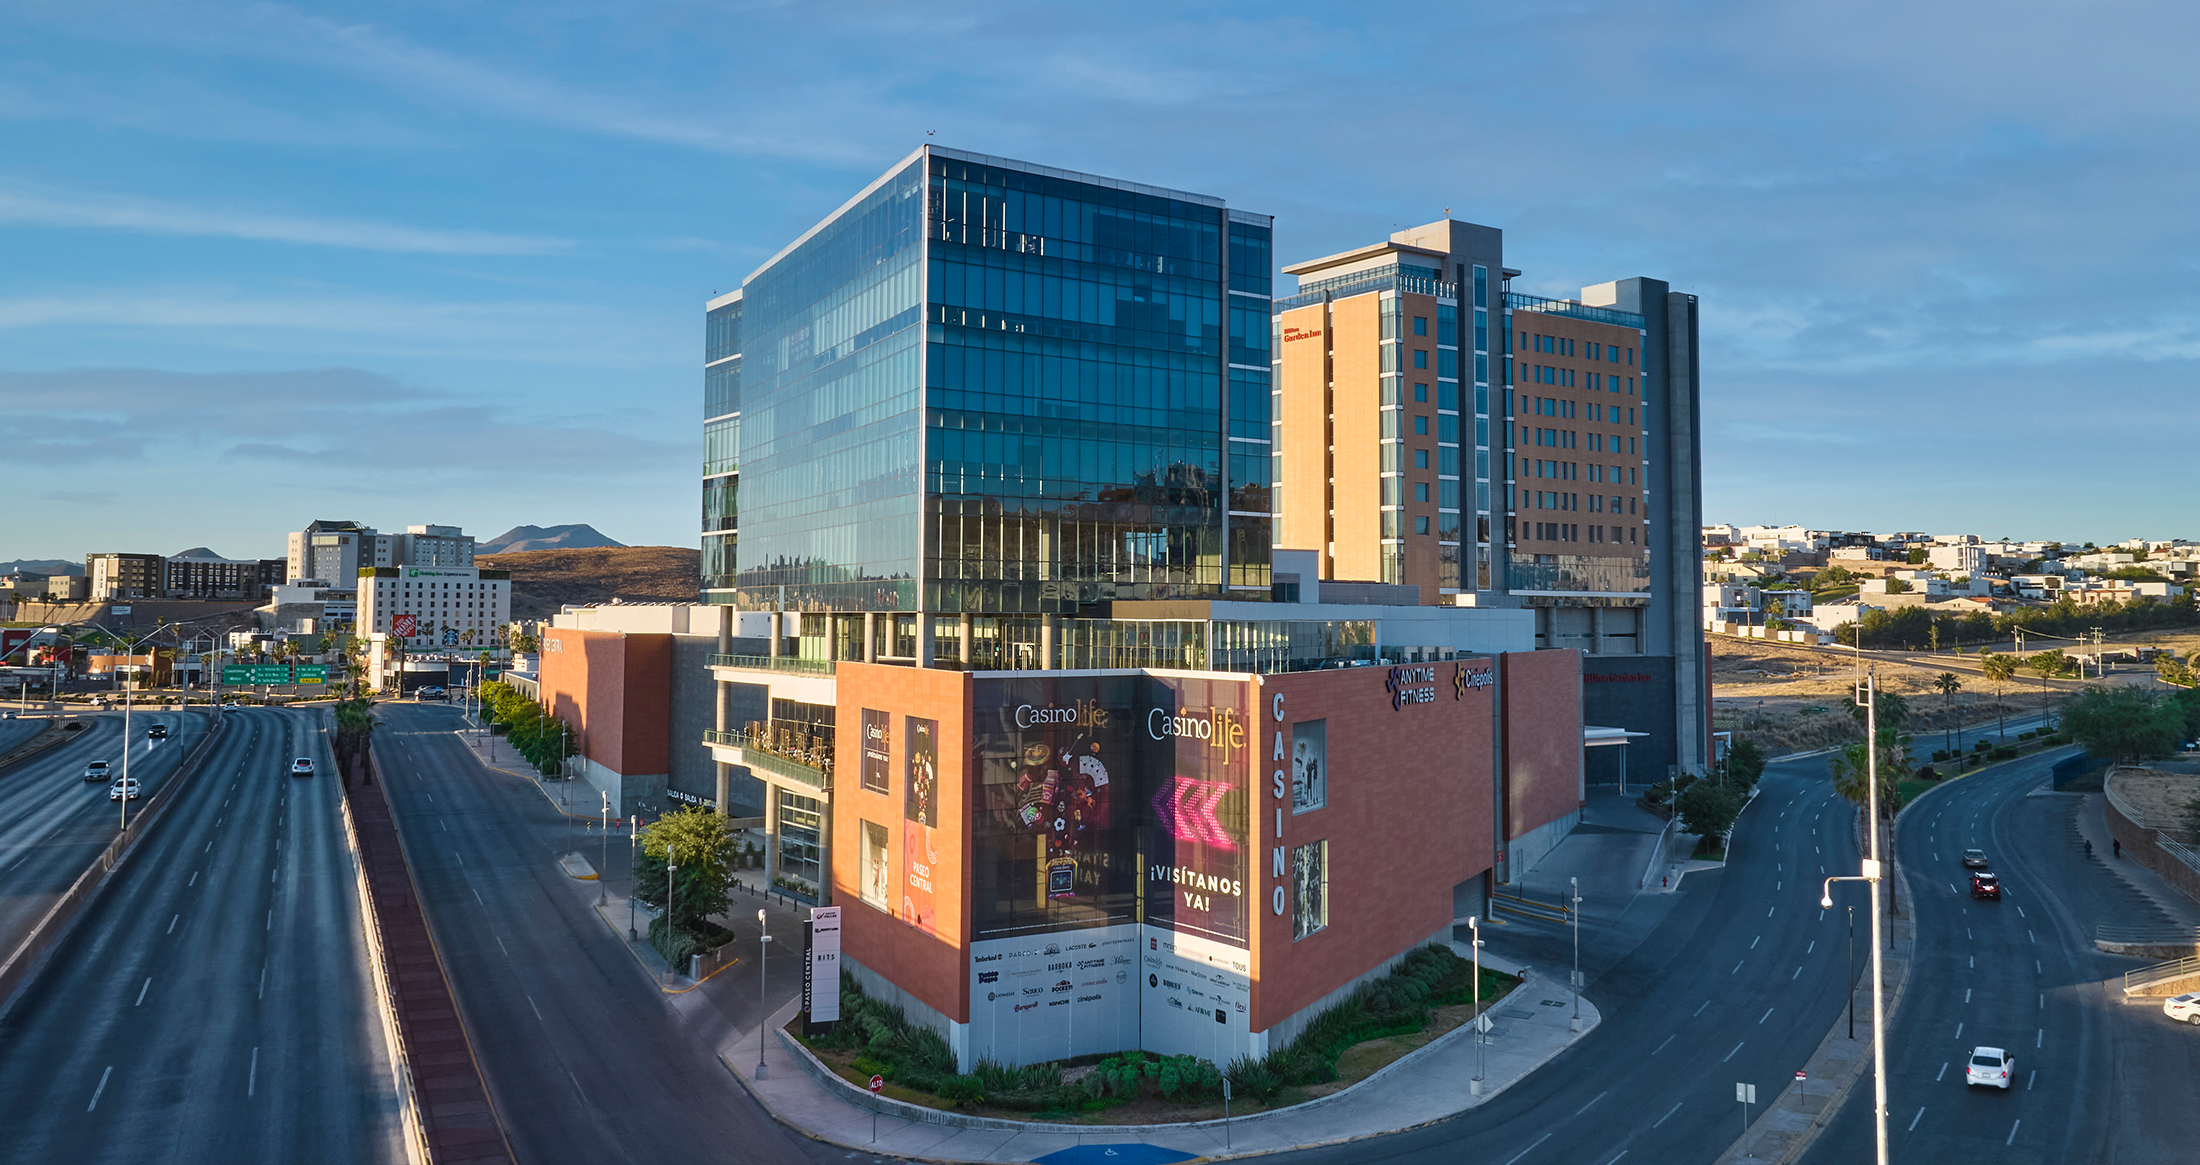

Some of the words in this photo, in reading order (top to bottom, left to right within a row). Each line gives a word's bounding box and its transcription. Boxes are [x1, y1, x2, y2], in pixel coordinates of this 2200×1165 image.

[1284, 333, 1309, 342] Garden
[393, 616, 414, 637] HOME
[1400, 667, 1434, 684] ANYTIME
[1400, 687, 1434, 705] FITNESS
[1272, 692, 1286, 916] CASINO
[913, 861, 930, 878] PASEO
[910, 873, 933, 894] CENTRAL
[1150, 864, 1241, 897] ¡VISÍTANOS
[1183, 892, 1210, 912] YA!
[1066, 943, 1087, 951] LACOSTE
[1232, 961, 1247, 972] TOUS
[1077, 994, 1102, 1003] cinépolis
[871, 1080, 882, 1089] ALTO
